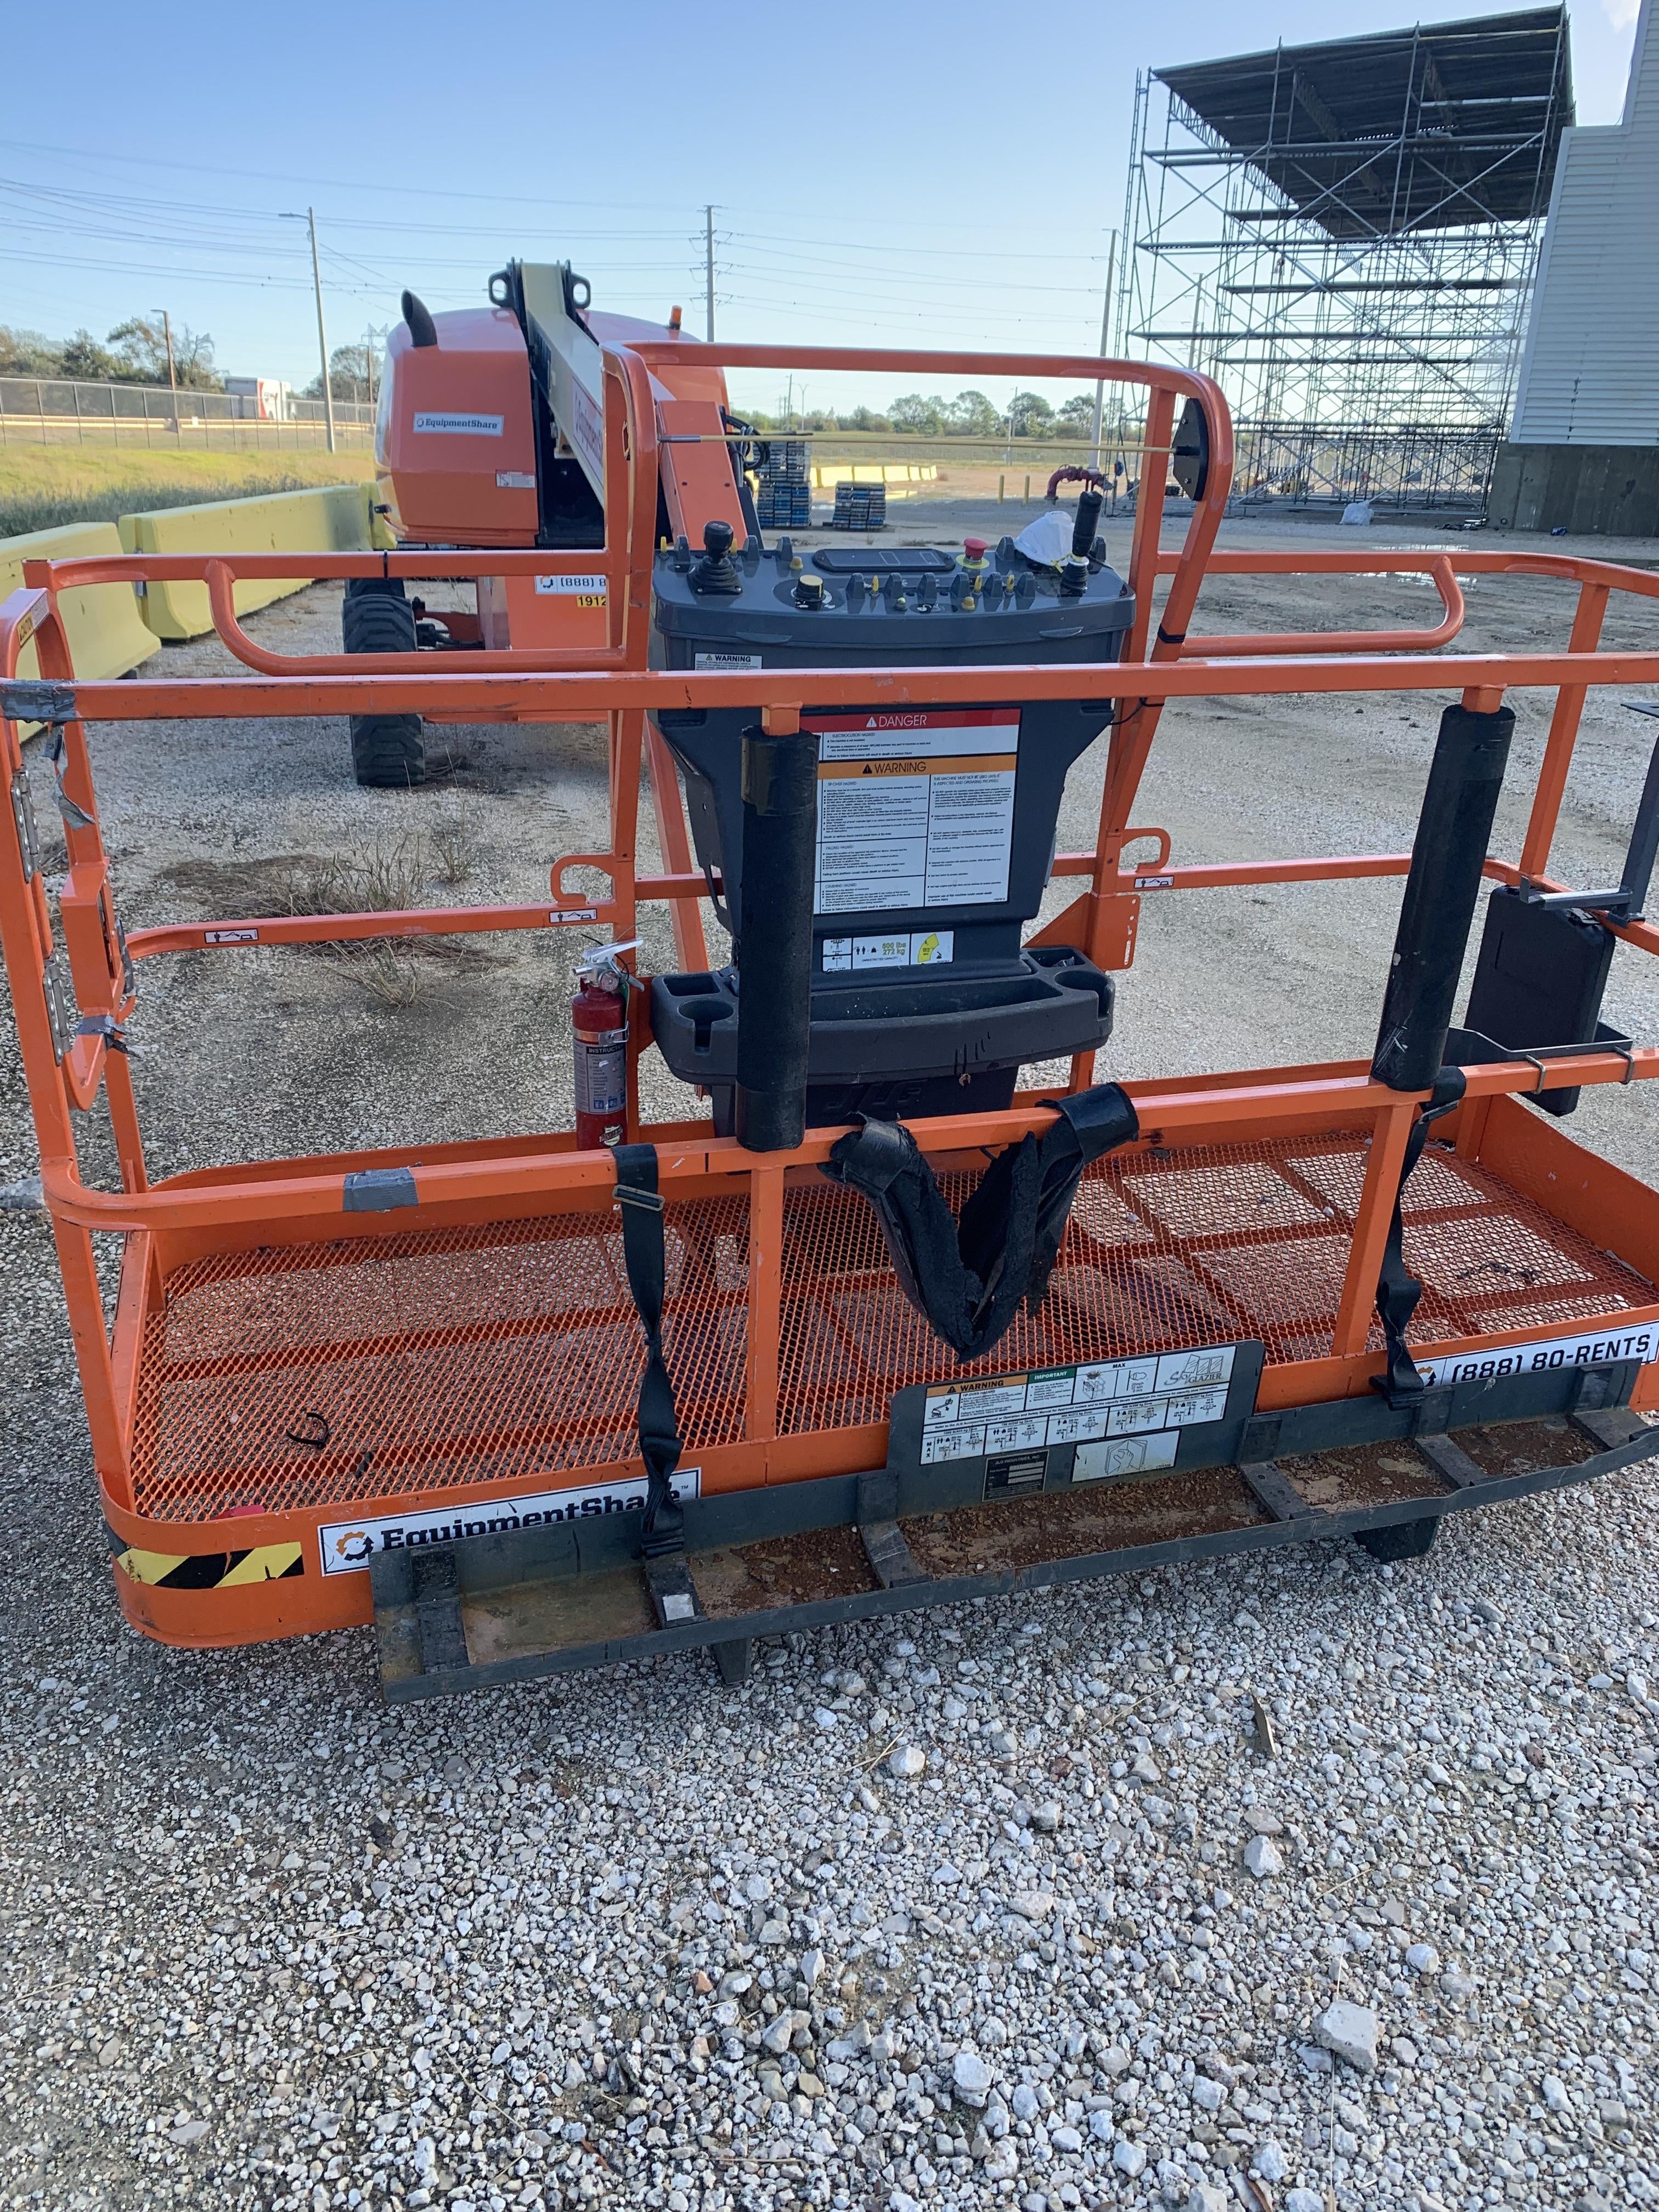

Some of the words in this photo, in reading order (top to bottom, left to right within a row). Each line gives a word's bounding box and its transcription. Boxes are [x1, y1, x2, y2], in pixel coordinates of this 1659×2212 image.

[425, 418, 498, 429] EquipmentShare
[561, 577, 594, 588] (888)
[578, 595, 606, 606] 1912
[879, 715, 927, 727] DANGER
[874, 761, 927, 774] WARNING
[1451, 1354, 1522, 1383] (888)
[1532, 1334, 1650, 1370] 80-RENTS
[1035, 1372, 1068, 1380] IMPORTANT
[961, 1380, 1004, 1392] WARNING
